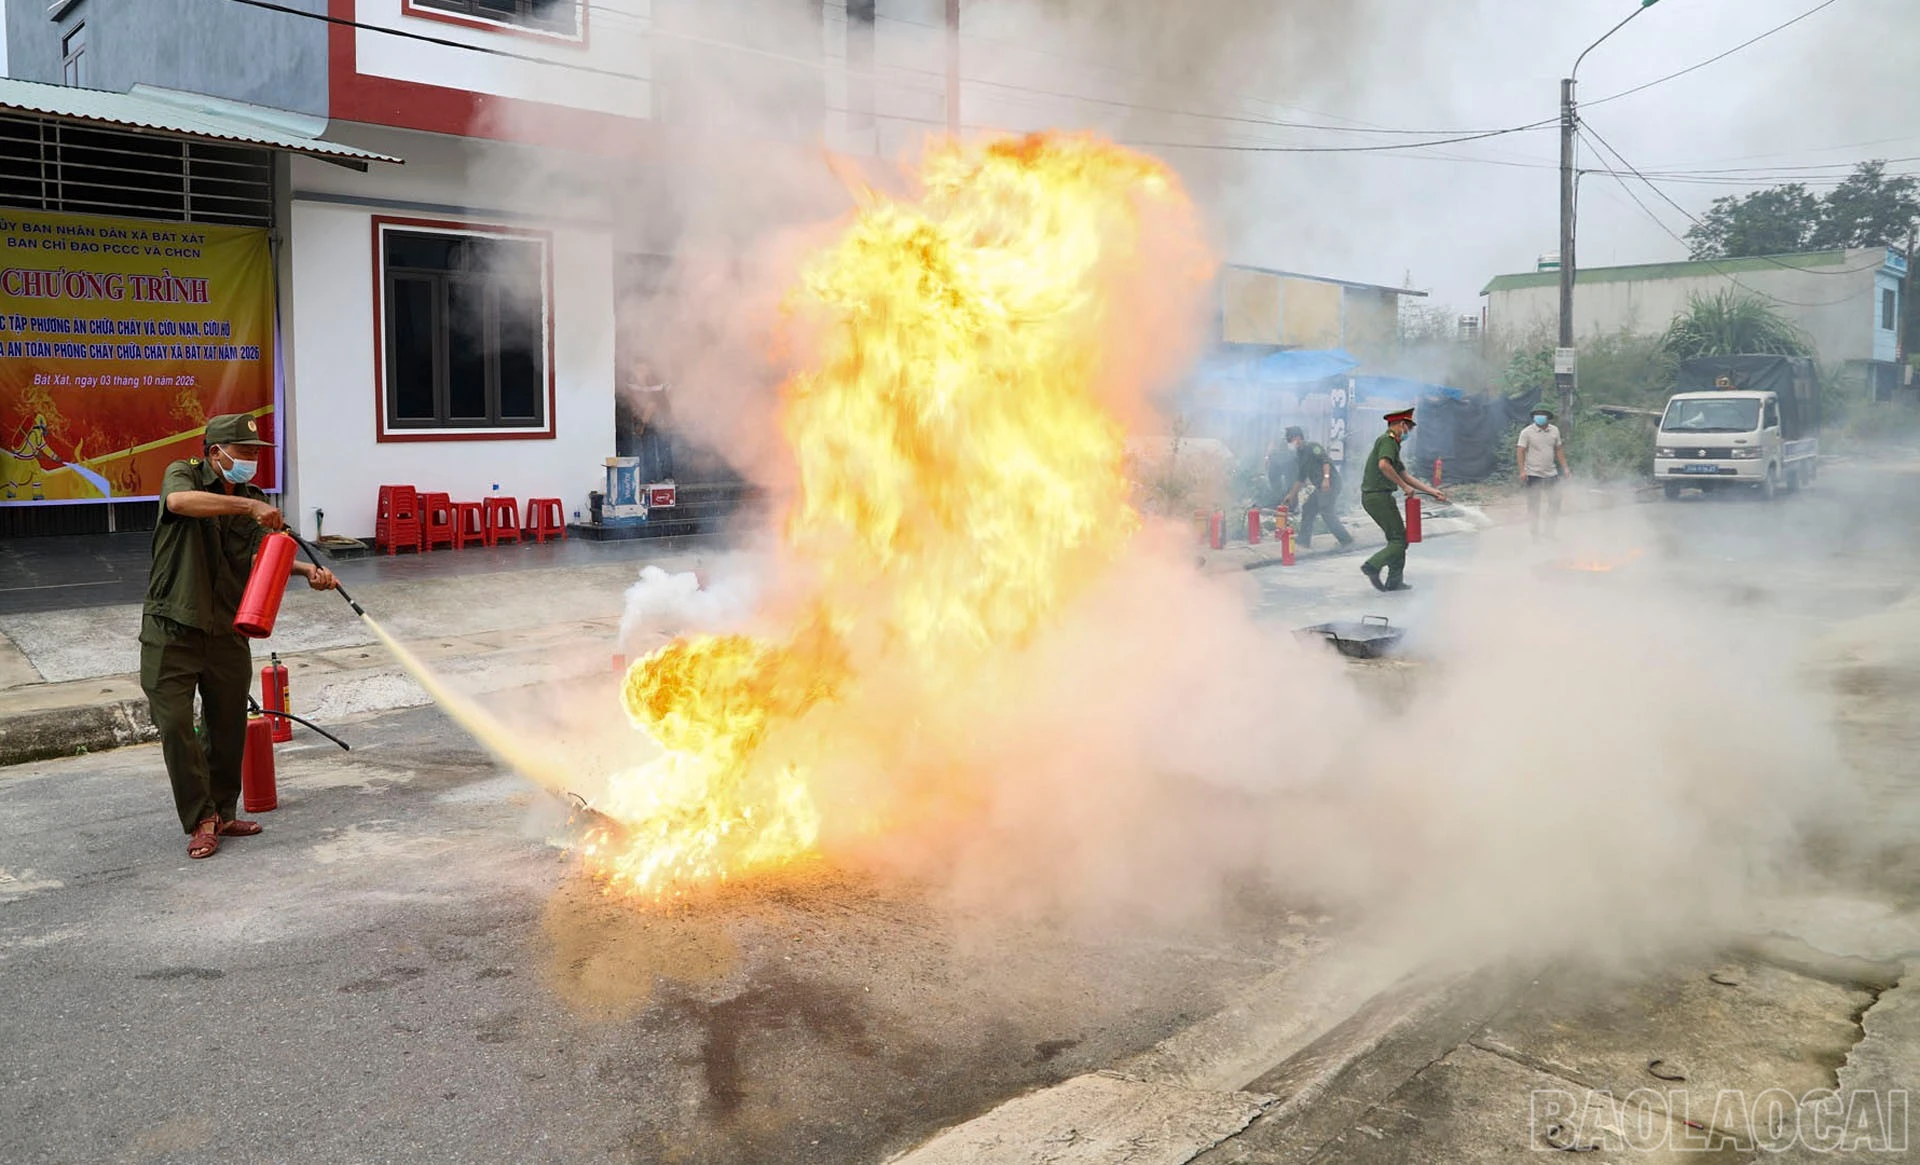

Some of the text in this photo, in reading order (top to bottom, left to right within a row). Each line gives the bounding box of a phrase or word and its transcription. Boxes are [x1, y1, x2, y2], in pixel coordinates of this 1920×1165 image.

[23, 222, 51, 234] BAN
[56, 225, 95, 237] NHÂN
[99, 227, 127, 239] DÂN
[7, 237, 37, 248] BAN
[70, 241, 99, 255] ĐẠO
[103, 244, 140, 255] PCCC
[144, 245, 161, 257] VÀ
[165, 247, 201, 259] CHCN
[1, 266, 210, 303] CHƯƠNG TRÌNH
[8, 313, 28, 335] TẬP
[30, 316, 71, 334] PHƯƠNG
[89, 317, 115, 335] CHỮA
[8, 341, 22, 357] AN
[25, 339, 51, 357] TOÀN
[54, 340, 87, 359] PHÒNG
[117, 342, 142, 360] CHỮA
[100, 375, 111, 386] 03
[113, 375, 140, 389] tháng
[143, 375, 153, 386] 10
